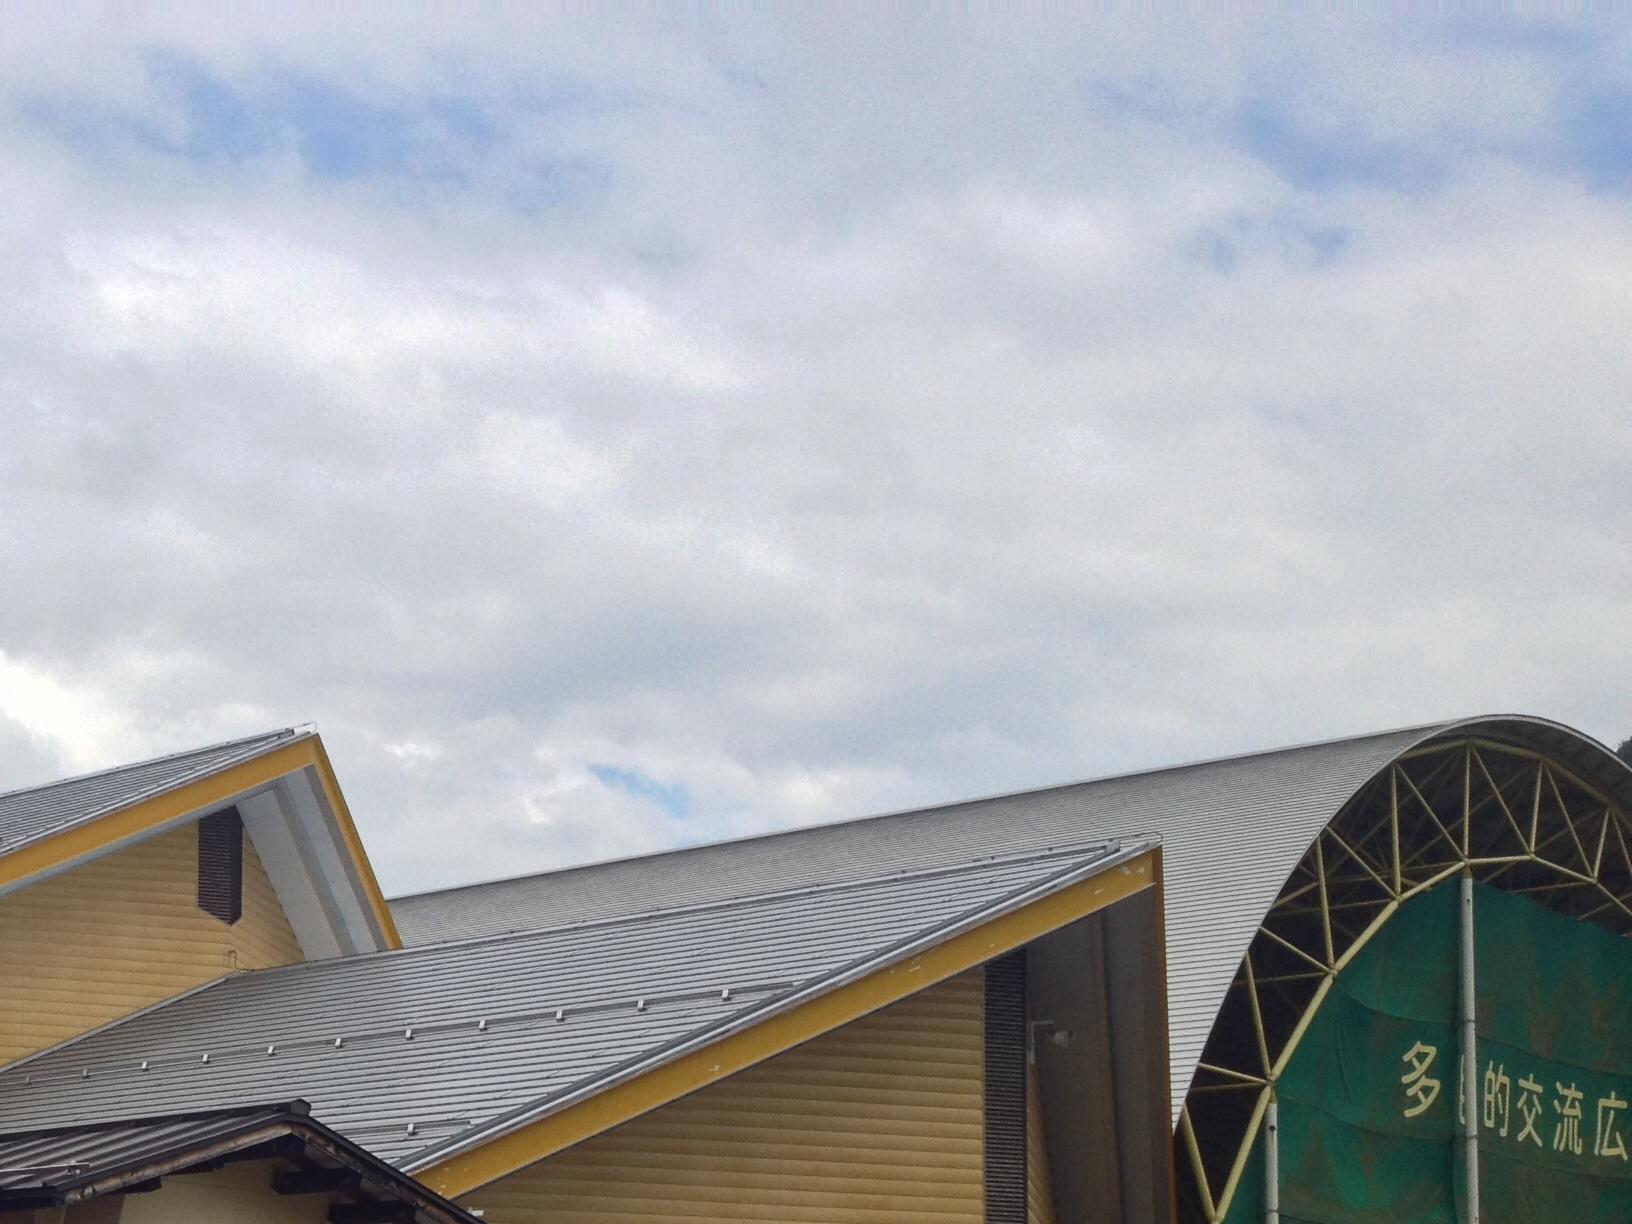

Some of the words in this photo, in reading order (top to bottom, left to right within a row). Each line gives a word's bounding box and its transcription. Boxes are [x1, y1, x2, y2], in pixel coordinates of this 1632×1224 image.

[1401, 1040, 1628, 1161] 多的交流広
